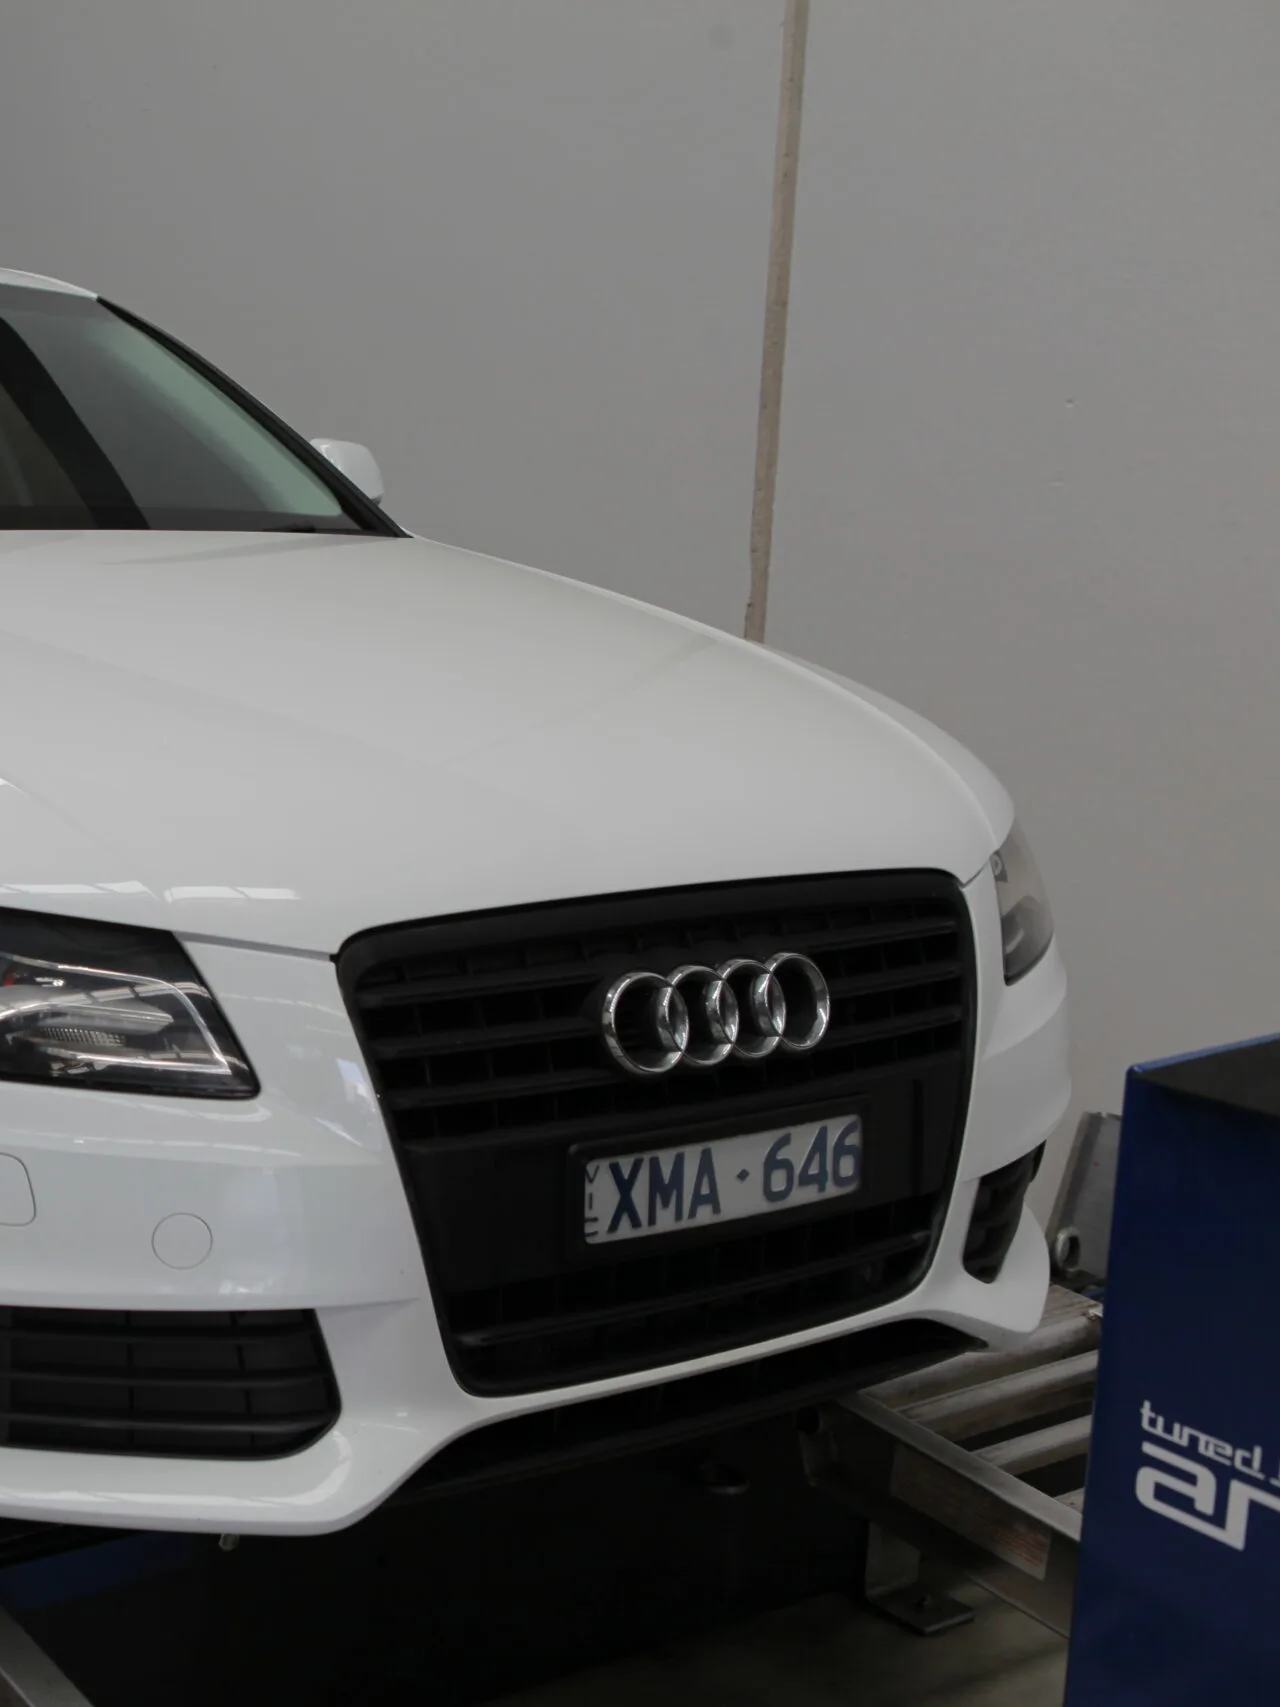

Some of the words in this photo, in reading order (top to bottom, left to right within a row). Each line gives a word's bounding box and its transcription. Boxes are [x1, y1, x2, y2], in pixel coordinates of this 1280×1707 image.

[606, 1147, 721, 1234] XMA
[763, 1120, 861, 1203] 646
[1139, 1399, 1267, 1480] tuned
